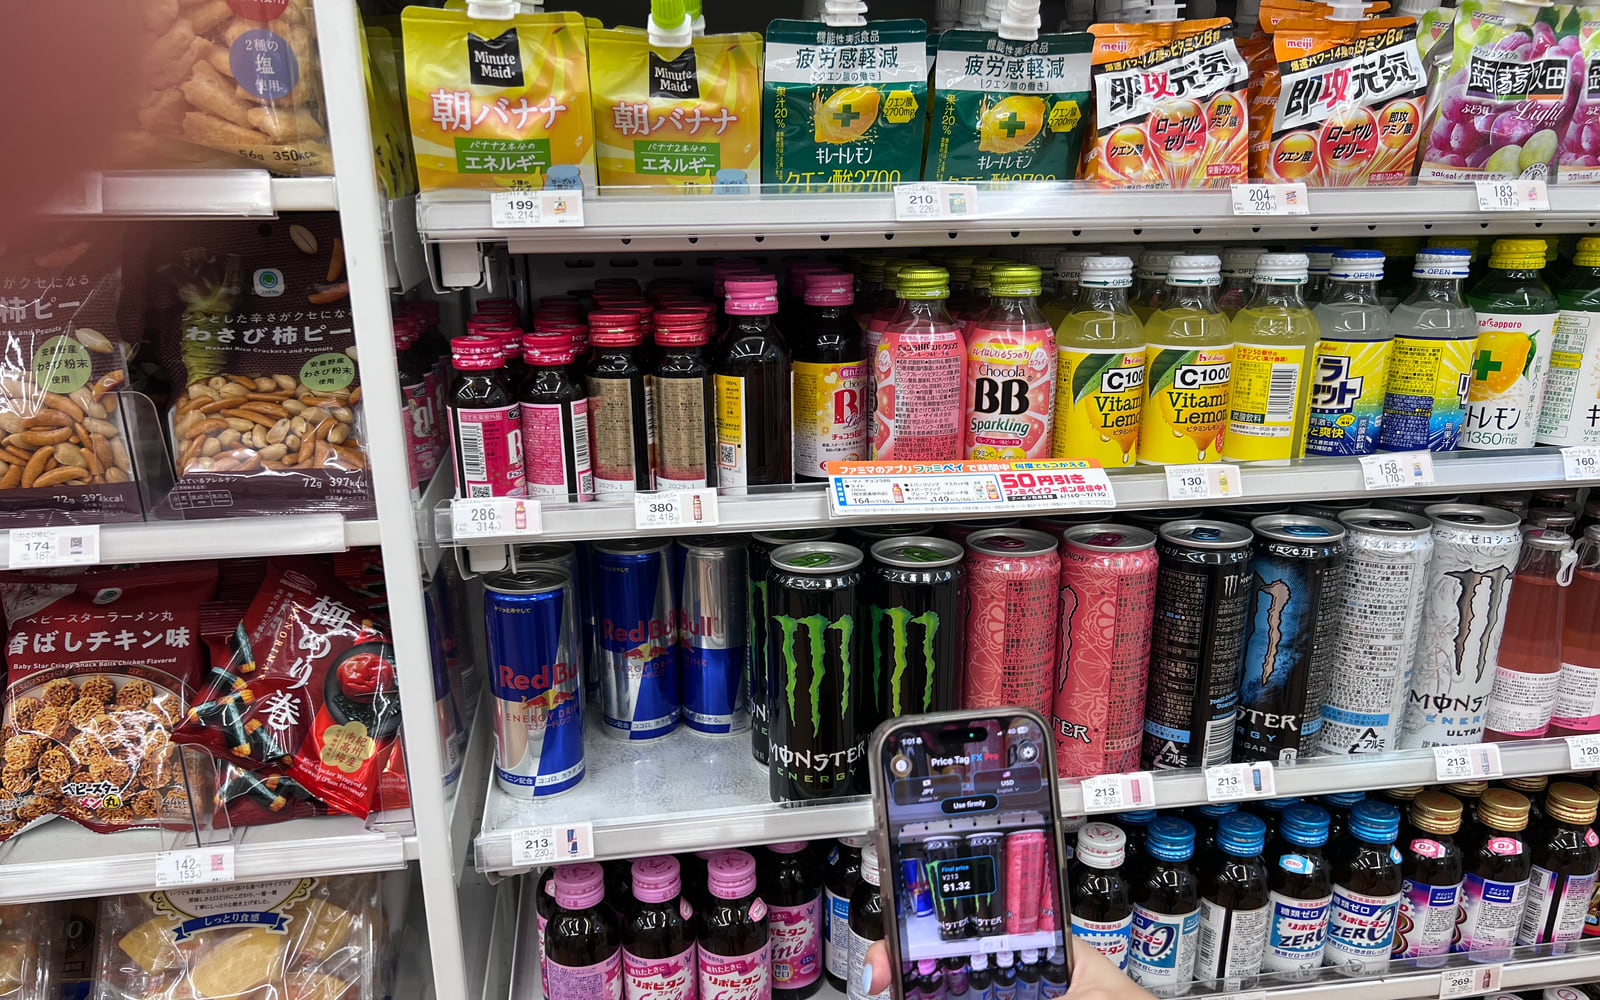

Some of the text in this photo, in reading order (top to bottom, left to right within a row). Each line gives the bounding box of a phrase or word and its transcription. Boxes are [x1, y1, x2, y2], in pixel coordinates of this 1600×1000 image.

[816, 30, 880, 44] 機能性表示食品
[1286, 38, 1314, 50] meiji
[245, 38, 279, 53] 2種の
[1100, 41, 1128, 54] meiji
[254, 54, 276, 75] 塩
[474, 50, 516, 66] Minute
[796, 46, 900, 70] 疲労感軽減
[654, 67, 694, 81] Minute
[964, 56, 1065, 80] 疲労感軽減
[1108, 49, 1238, 113] 即攻元気
[1468, 60, 1567, 94] 蒟蒻畑
[255, 78, 281, 93] 使用
[1284, 51, 1418, 119] 即攻元気
[887, 97, 913, 108] クエン酸
[430, 88, 568, 132] 朝バナナ
[1215, 103, 1233, 117] 即攻
[1510, 100, 1566, 127] Light
[612, 101, 738, 137] 朝バナナ
[1154, 114, 1202, 134] ローヤル
[1390, 112, 1410, 124] 即攻
[1326, 124, 1374, 143] ローヤル
[1110, 144, 1145, 158] クエン酸
[1163, 136, 1196, 153] ゼリー
[1332, 141, 1366, 158] ゼリー
[815, 147, 873, 166] キレートレモン
[976, 155, 1033, 170] キレートレモン
[1276, 150, 1313, 164] クエン酸
[464, 155, 546, 173] エネルギー
[642, 157, 717, 174] エネルギー
[1248, 188, 1270, 202] 204
[1494, 186, 1513, 198] 183
[508, 200, 534, 211] 199
[909, 195, 934, 205] 210
[1254, 201, 1272, 211] 220
[1499, 197, 1515, 206] 197
[518, 210, 534, 220] 214
[1427, 268, 1452, 276] OPEN
[1487, 318, 1522, 329] sapporo
[186, 325, 352, 346] わさび柿ピー
[304, 366, 354, 378] わさび粉末
[978, 364, 1026, 378] Chocola
[52, 375, 71, 384] 使用
[318, 378, 336, 386] 使用
[974, 377, 1030, 416] BB
[970, 417, 1030, 437] Sparkling
[1466, 430, 1518, 446] 1350mg
[1576, 457, 1594, 466] 160
[1378, 462, 1398, 476] 158
[302, 478, 323, 489] 72g
[1000, 473, 1086, 489] 50円引き
[1180, 477, 1202, 486] 130
[1385, 474, 1400, 484] 170
[1005, 484, 1108, 496] ファミペイクーポン配信中!
[81, 492, 124, 504] 397kcal
[472, 508, 496, 522] 286
[649, 503, 674, 513] 380
[659, 512, 674, 521] 418
[477, 522, 495, 532] 314
[24, 542, 50, 552] 174
[26, 610, 174, 624] ベビースターラーメン丸
[602, 618, 646, 643] Red
[7, 626, 191, 656] 香ばしチキン味
[13, 663, 32, 671] Baby
[50, 661, 74, 670] Crispy
[118, 657, 144, 666] Chicken
[146, 656, 178, 665] Flavored
[260, 594, 355, 732] 梅のり巻
[499, 664, 550, 691] Red
[506, 712, 553, 724] ENERGY
[1446, 726, 1482, 738] ULTRA
[1580, 746, 1600, 756] 120
[930, 752, 999, 768] Price Tag FX Pro
[1446, 757, 1466, 767] 213
[777, 766, 857, 784] ENERGY
[1454, 766, 1468, 775] 230
[62, 780, 120, 796] ベビースター
[1218, 776, 1238, 786] 213
[921, 788, 934, 796] JPY
[1094, 788, 1116, 798] 213
[1226, 786, 1239, 794] 230
[953, 798, 986, 810] Use firmly
[1103, 796, 1118, 806] 230
[525, 838, 550, 849] 213
[534, 849, 551, 859] 230
[174, 858, 196, 872] 142
[954, 864, 969, 874] price
[178, 870, 196, 880] 153
[942, 881, 971, 893] $1.32
[1333, 894, 1370, 914] 糖類ゼロ
[204, 912, 261, 926] しっとり食感
[1280, 907, 1320, 918] 糖類ゼロ
[1330, 906, 1395, 942] ZERO
[1338, 912, 1388, 929] リポビタン
[632, 972, 686, 991] リポビタン
[708, 972, 762, 990] リポビタン
[1452, 978, 1470, 987] 269
